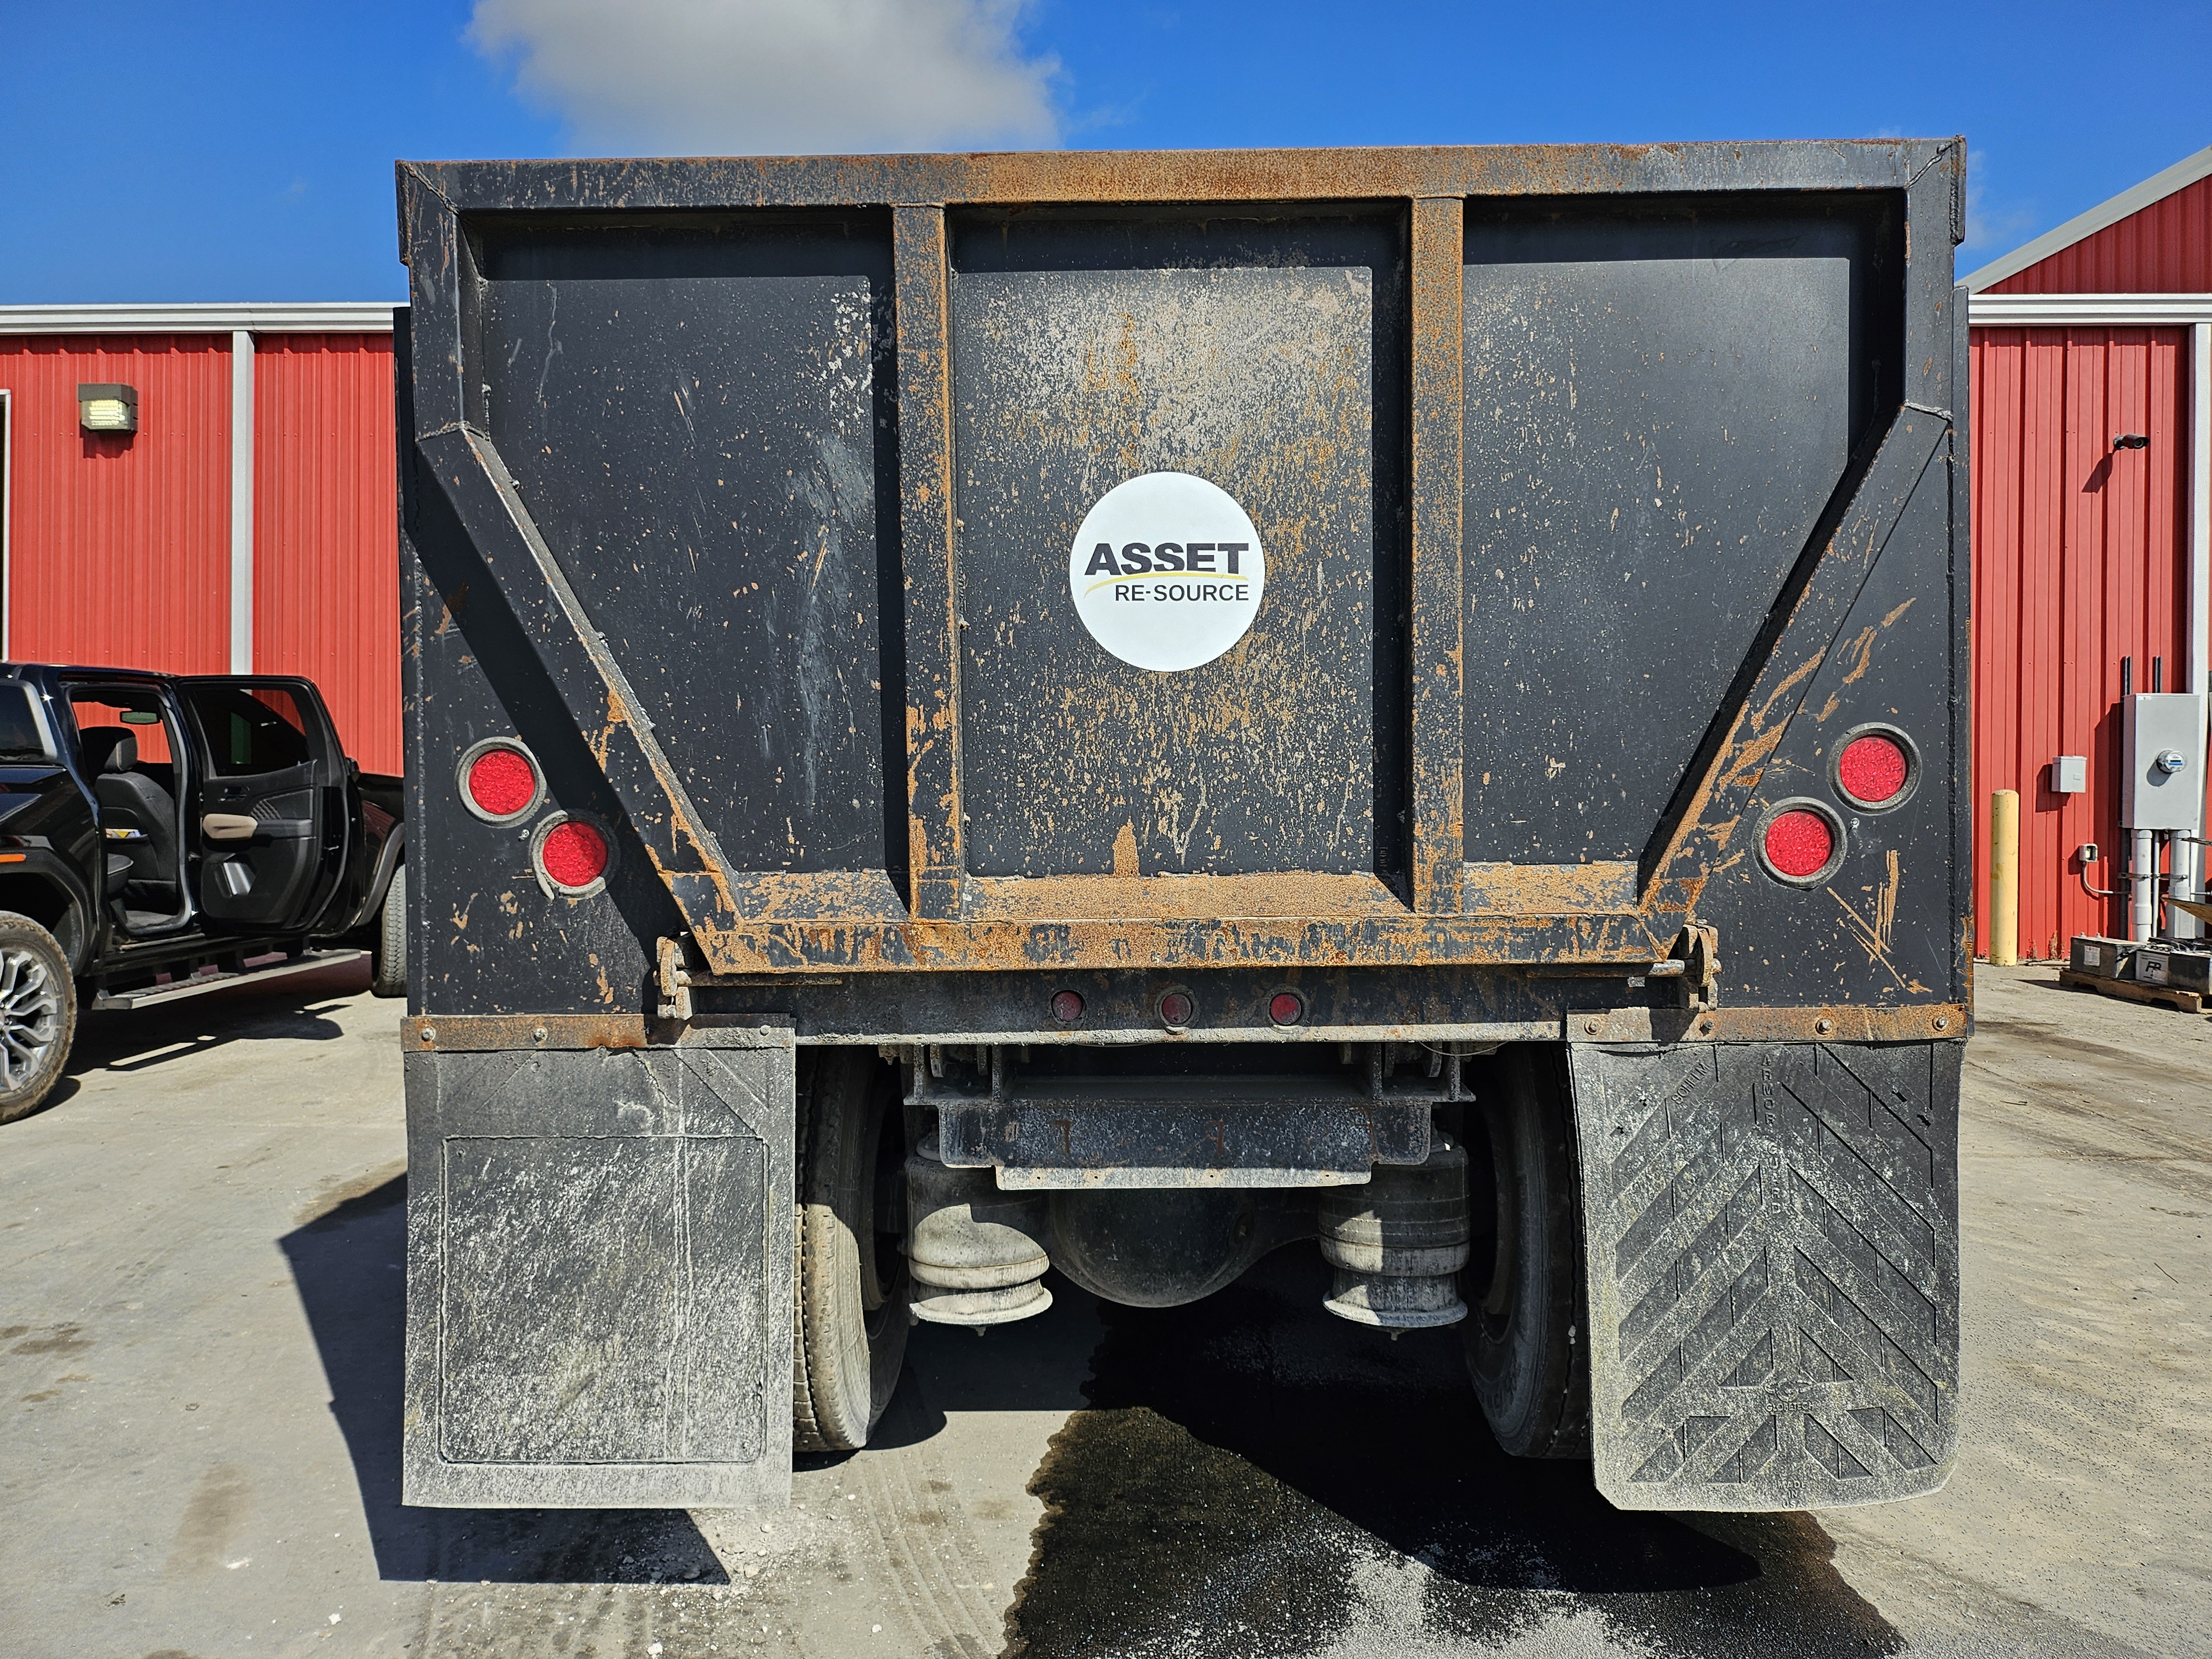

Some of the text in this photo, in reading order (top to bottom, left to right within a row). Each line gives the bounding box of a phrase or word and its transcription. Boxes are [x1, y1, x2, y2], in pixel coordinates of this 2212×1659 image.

[1084, 542, 1249, 575] ASSET
[1115, 585, 1249, 601] RE-SOURCE
[1761, 1054, 1776, 1125] ARMOR
[1777, 1480, 1806, 1489] MADE
[1787, 1489, 1797, 1499] IN
[1781, 1500, 1804, 1509] USA
